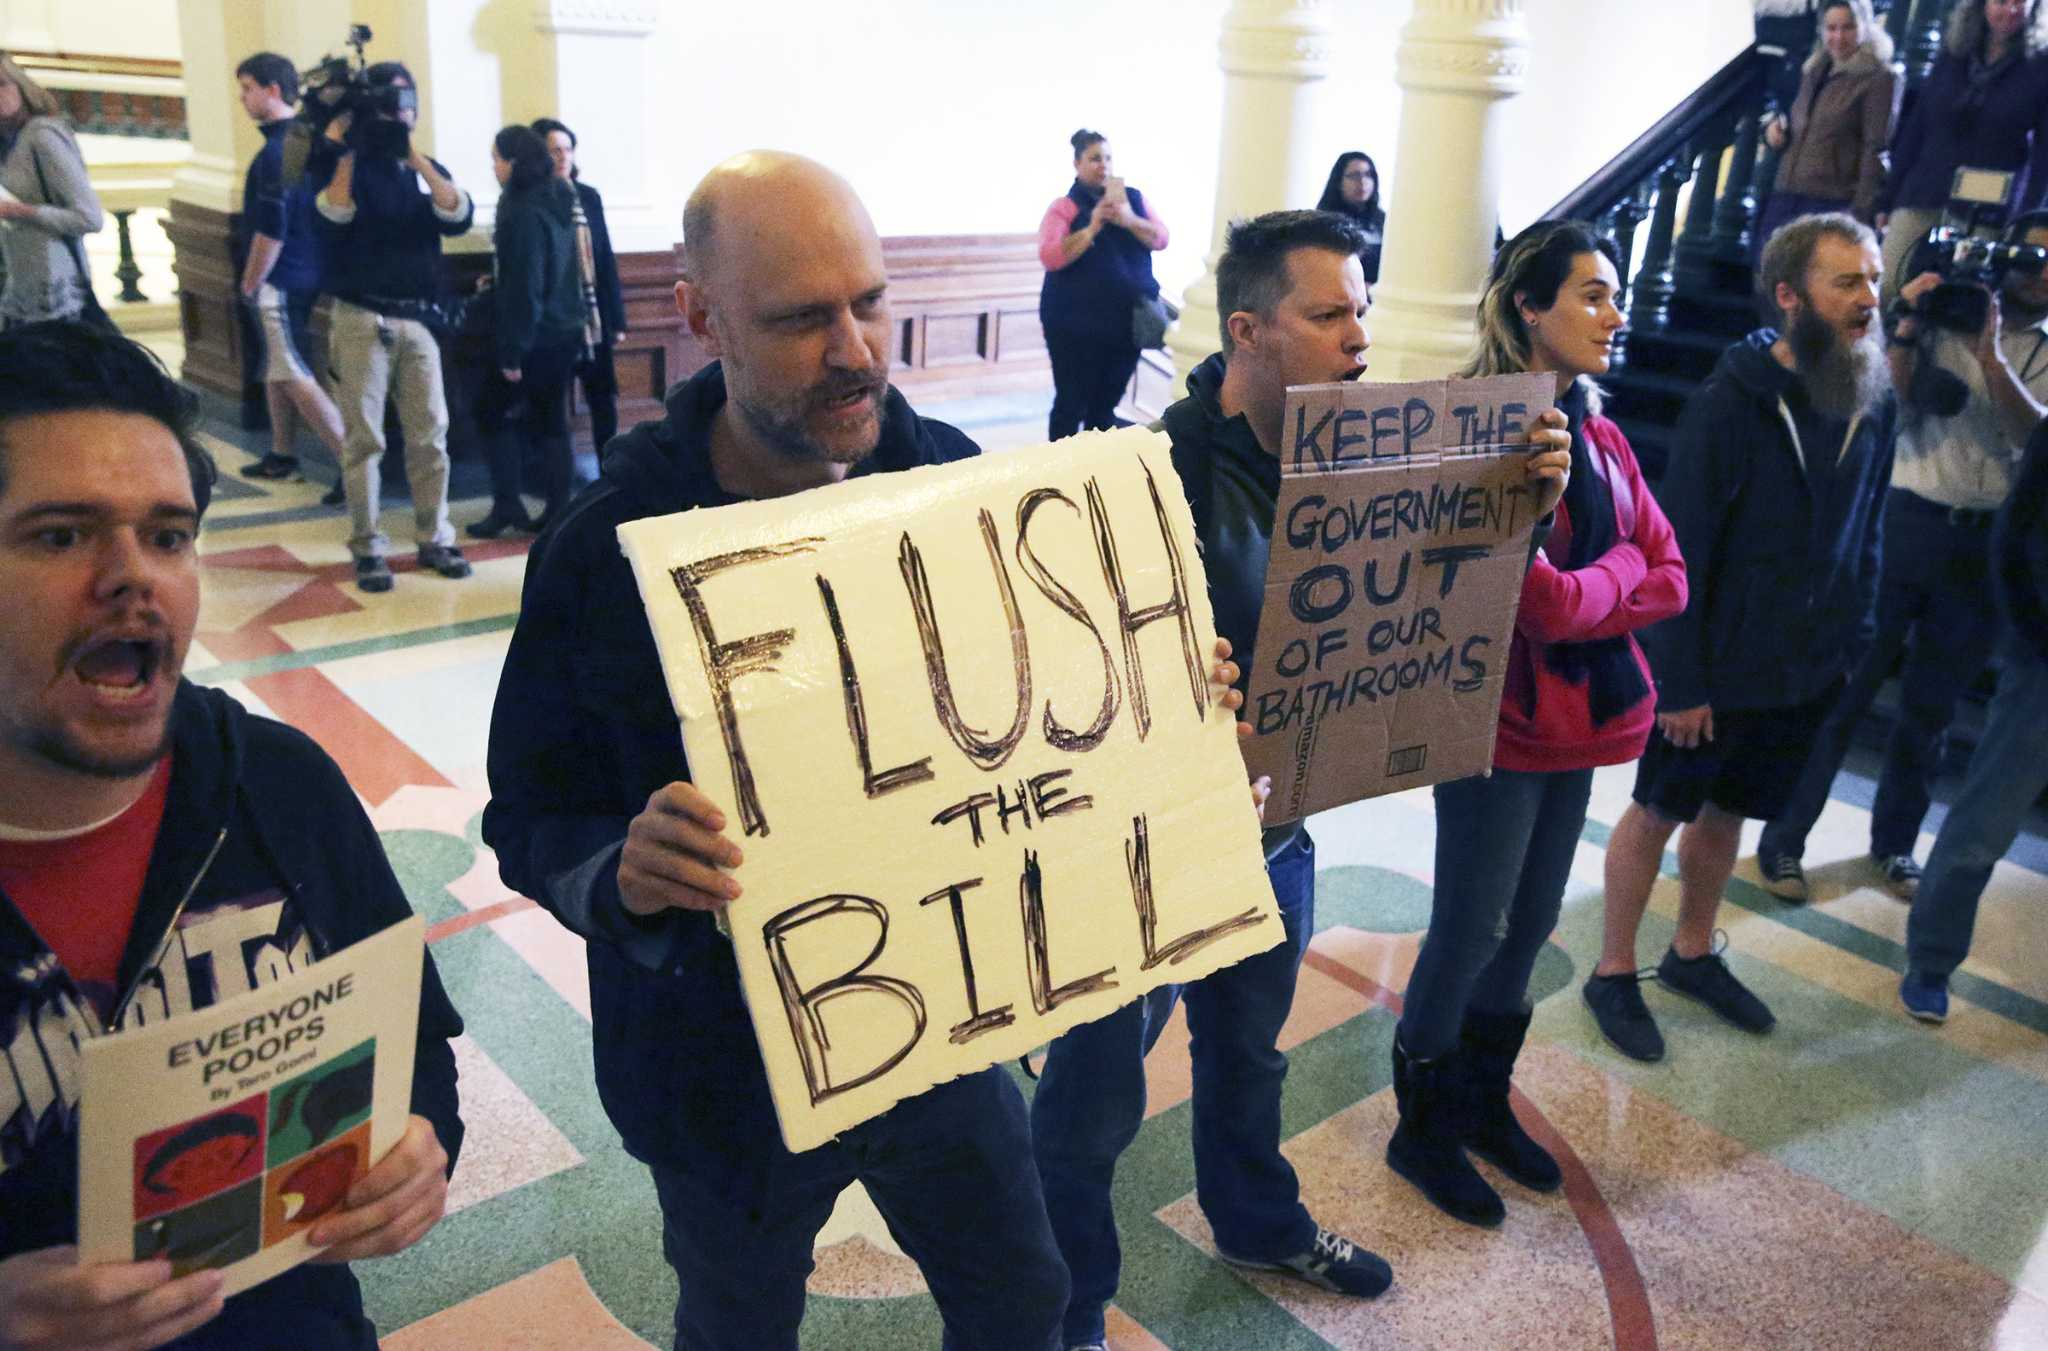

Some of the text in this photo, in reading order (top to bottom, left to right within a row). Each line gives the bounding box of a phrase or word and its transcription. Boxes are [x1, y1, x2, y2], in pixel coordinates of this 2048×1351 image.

[1294, 397, 1528, 474] KEEP THE
[1286, 483, 1529, 552] GOVERNMENT
[1289, 544, 1493, 623] OUT
[669, 454, 1212, 837] FLUSH
[1275, 607, 1446, 678] OF OUR
[1256, 635, 1491, 736] BATHROOMS
[931, 768, 1093, 848] THE
[762, 812, 1268, 1108] BILL
[168, 973, 354, 1068] EVERYONE
[203, 1016, 326, 1084] POOPS
[210, 1087, 231, 1101] By
